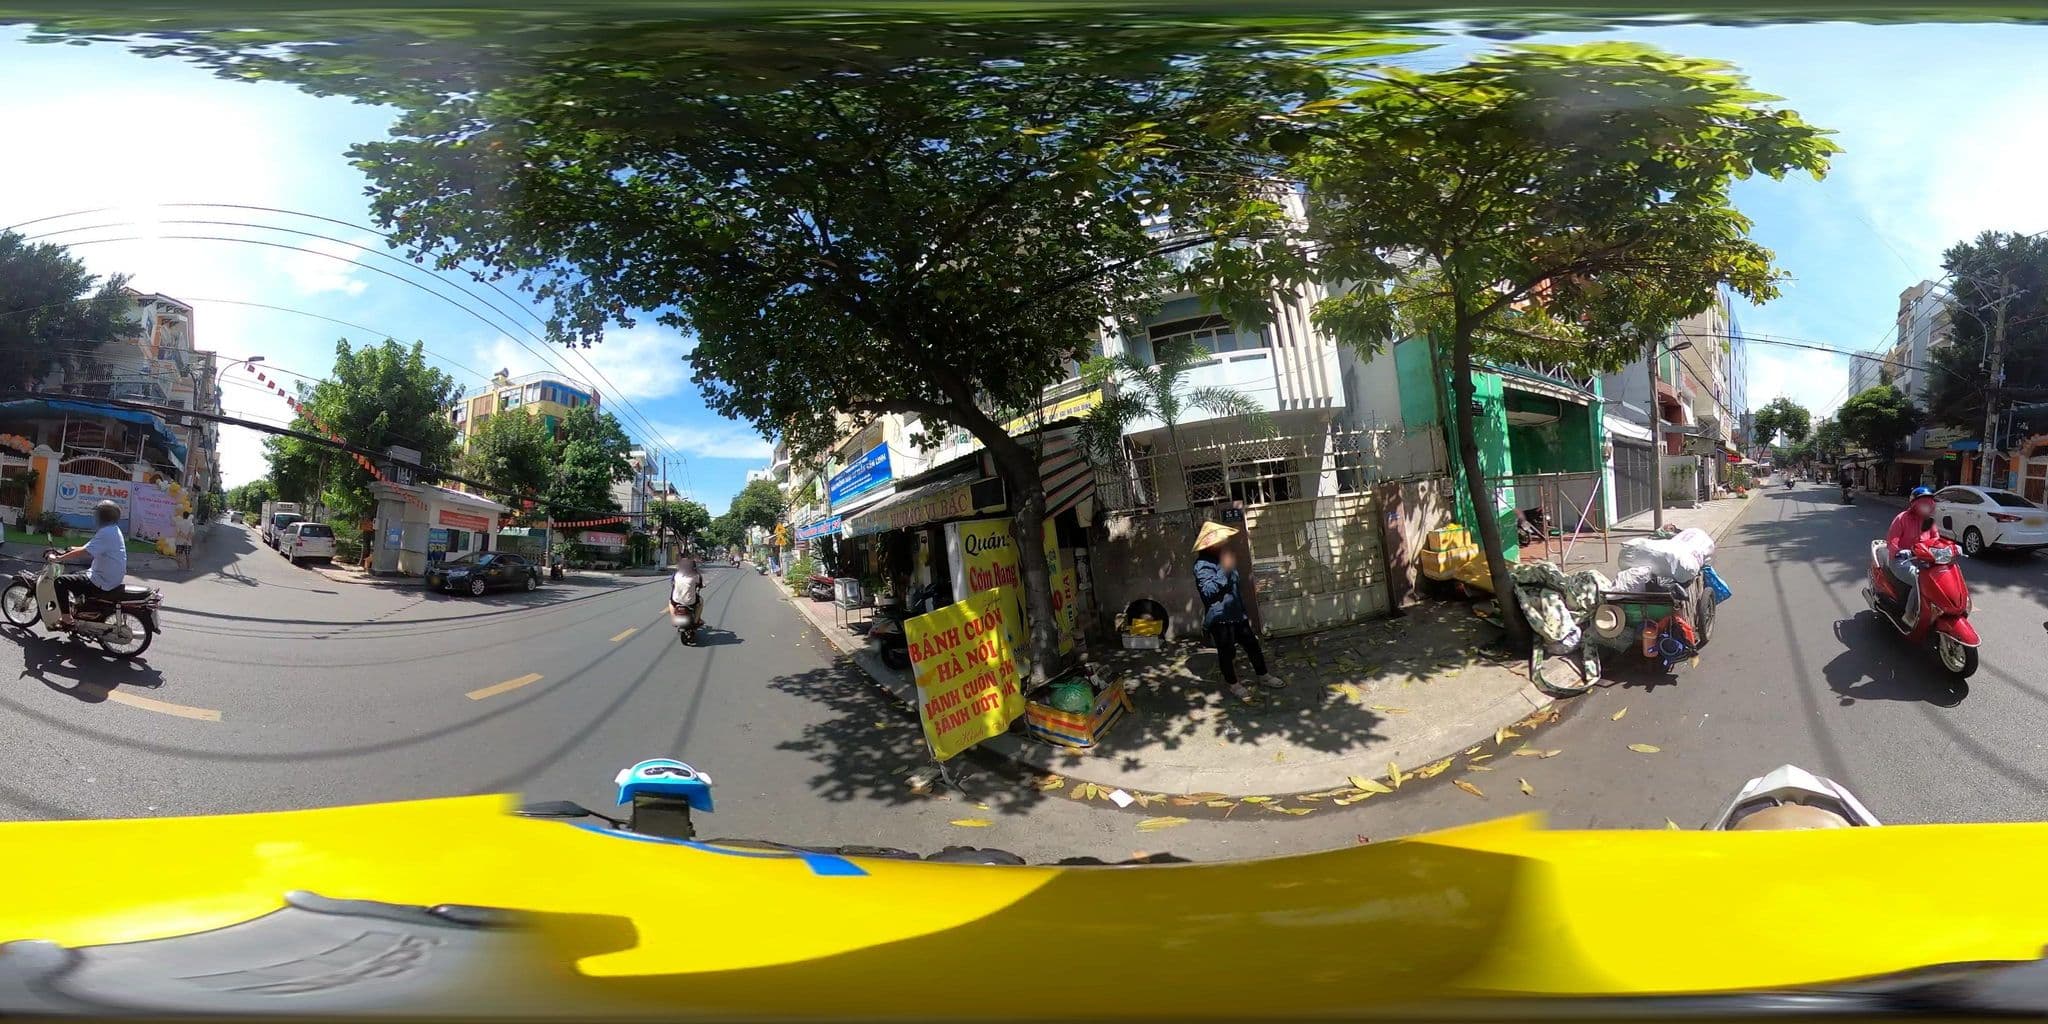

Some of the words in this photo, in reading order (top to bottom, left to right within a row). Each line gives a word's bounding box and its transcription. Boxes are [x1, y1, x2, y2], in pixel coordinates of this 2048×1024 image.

[908, 626, 961, 663] BÁNH
[963, 608, 1004, 641] CUỐN
[936, 653, 964, 684] HÀ
[965, 639, 998, 668] NỘI
